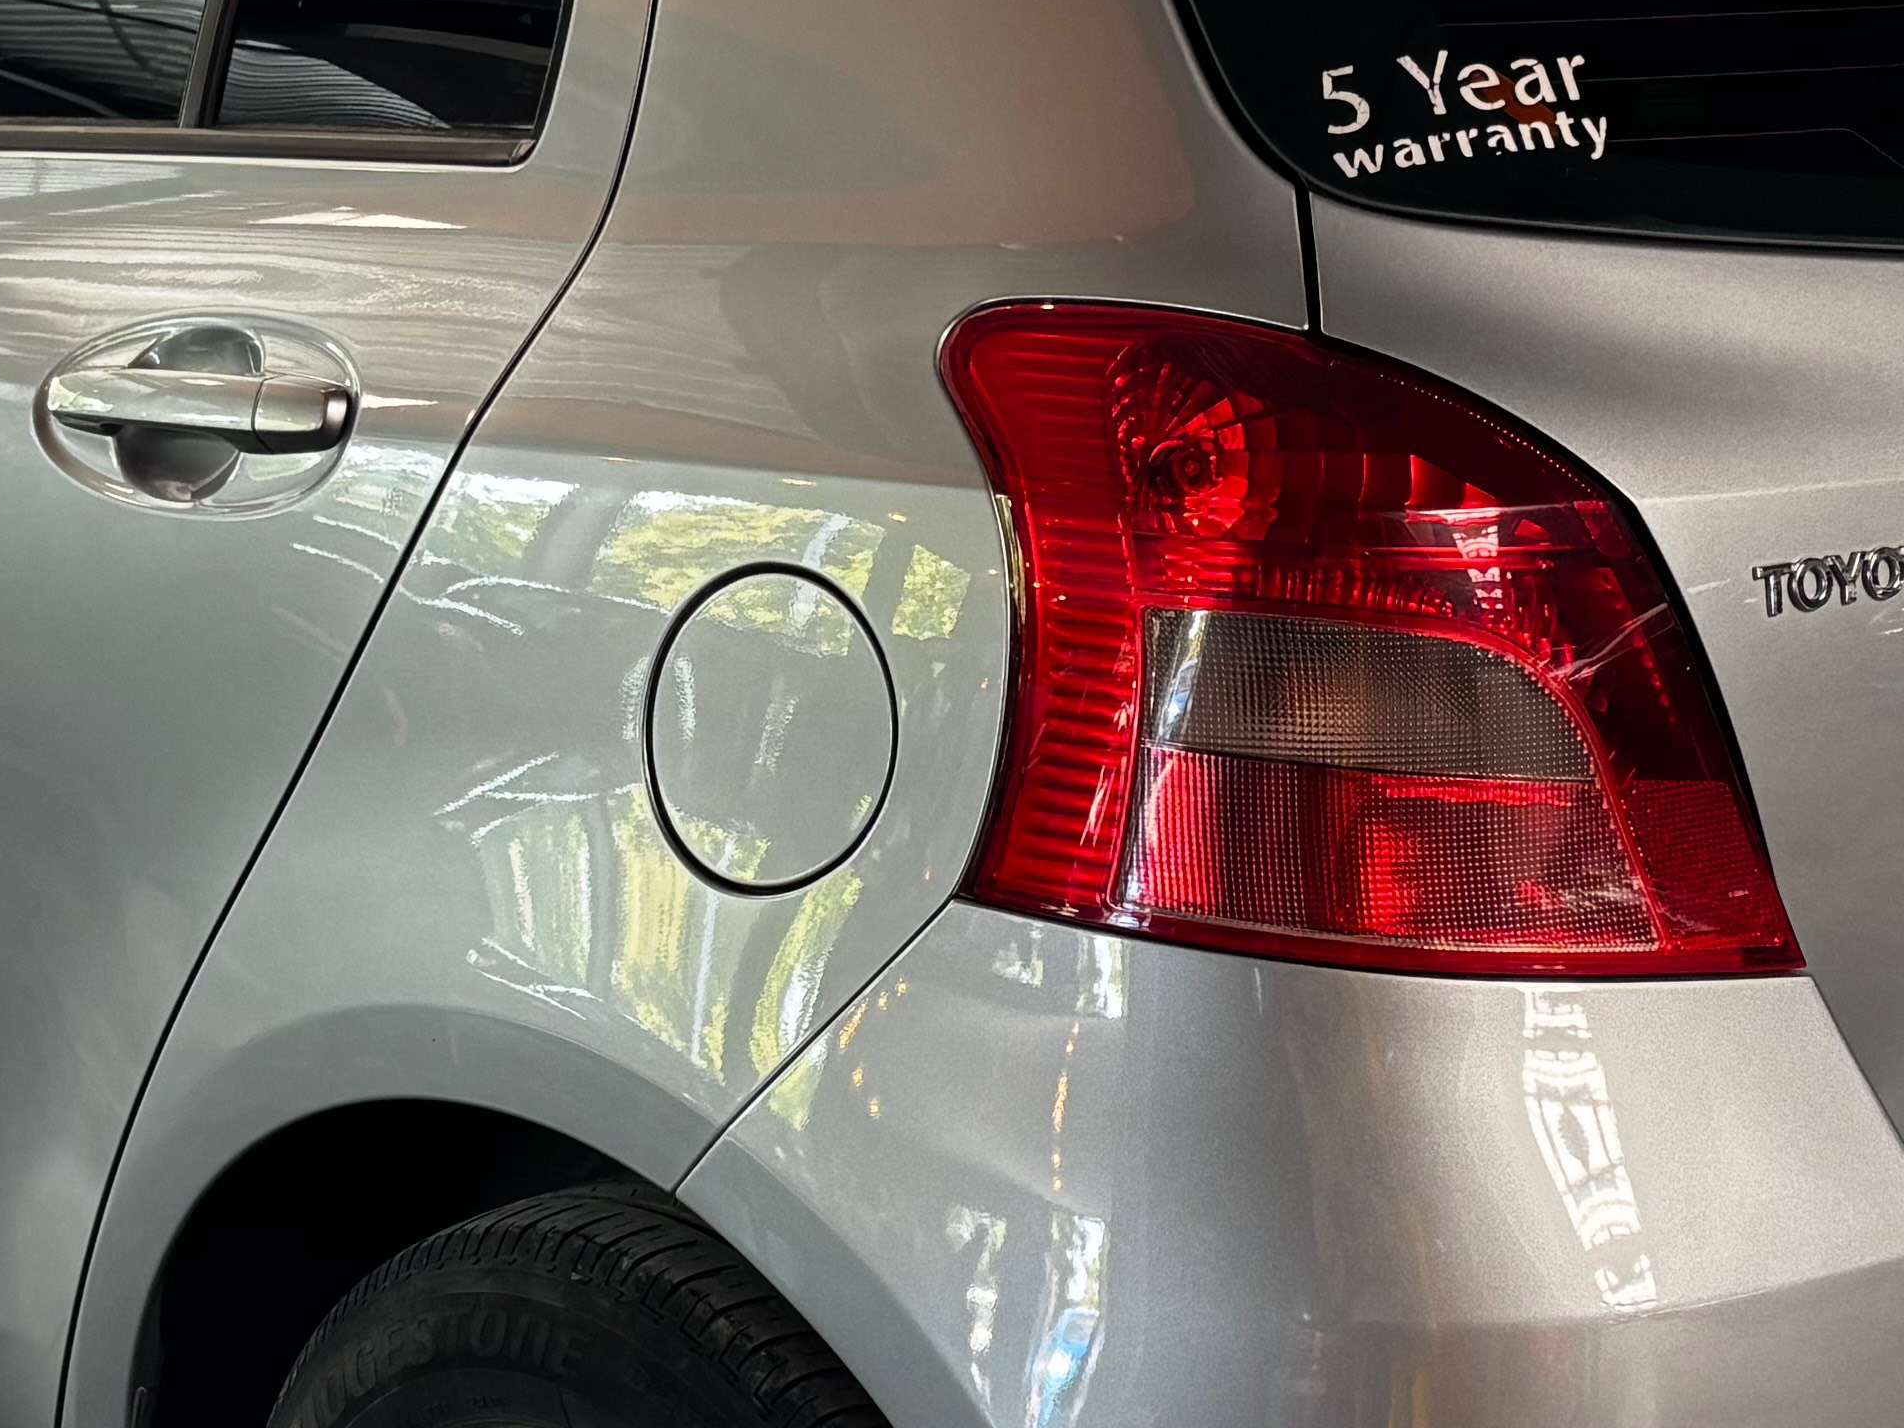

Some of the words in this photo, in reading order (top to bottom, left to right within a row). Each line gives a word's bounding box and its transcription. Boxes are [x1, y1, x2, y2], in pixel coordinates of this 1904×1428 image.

[1322, 65, 1371, 135] 5
[1396, 49, 1586, 116] Year
[1332, 110, 1608, 179] warranty
